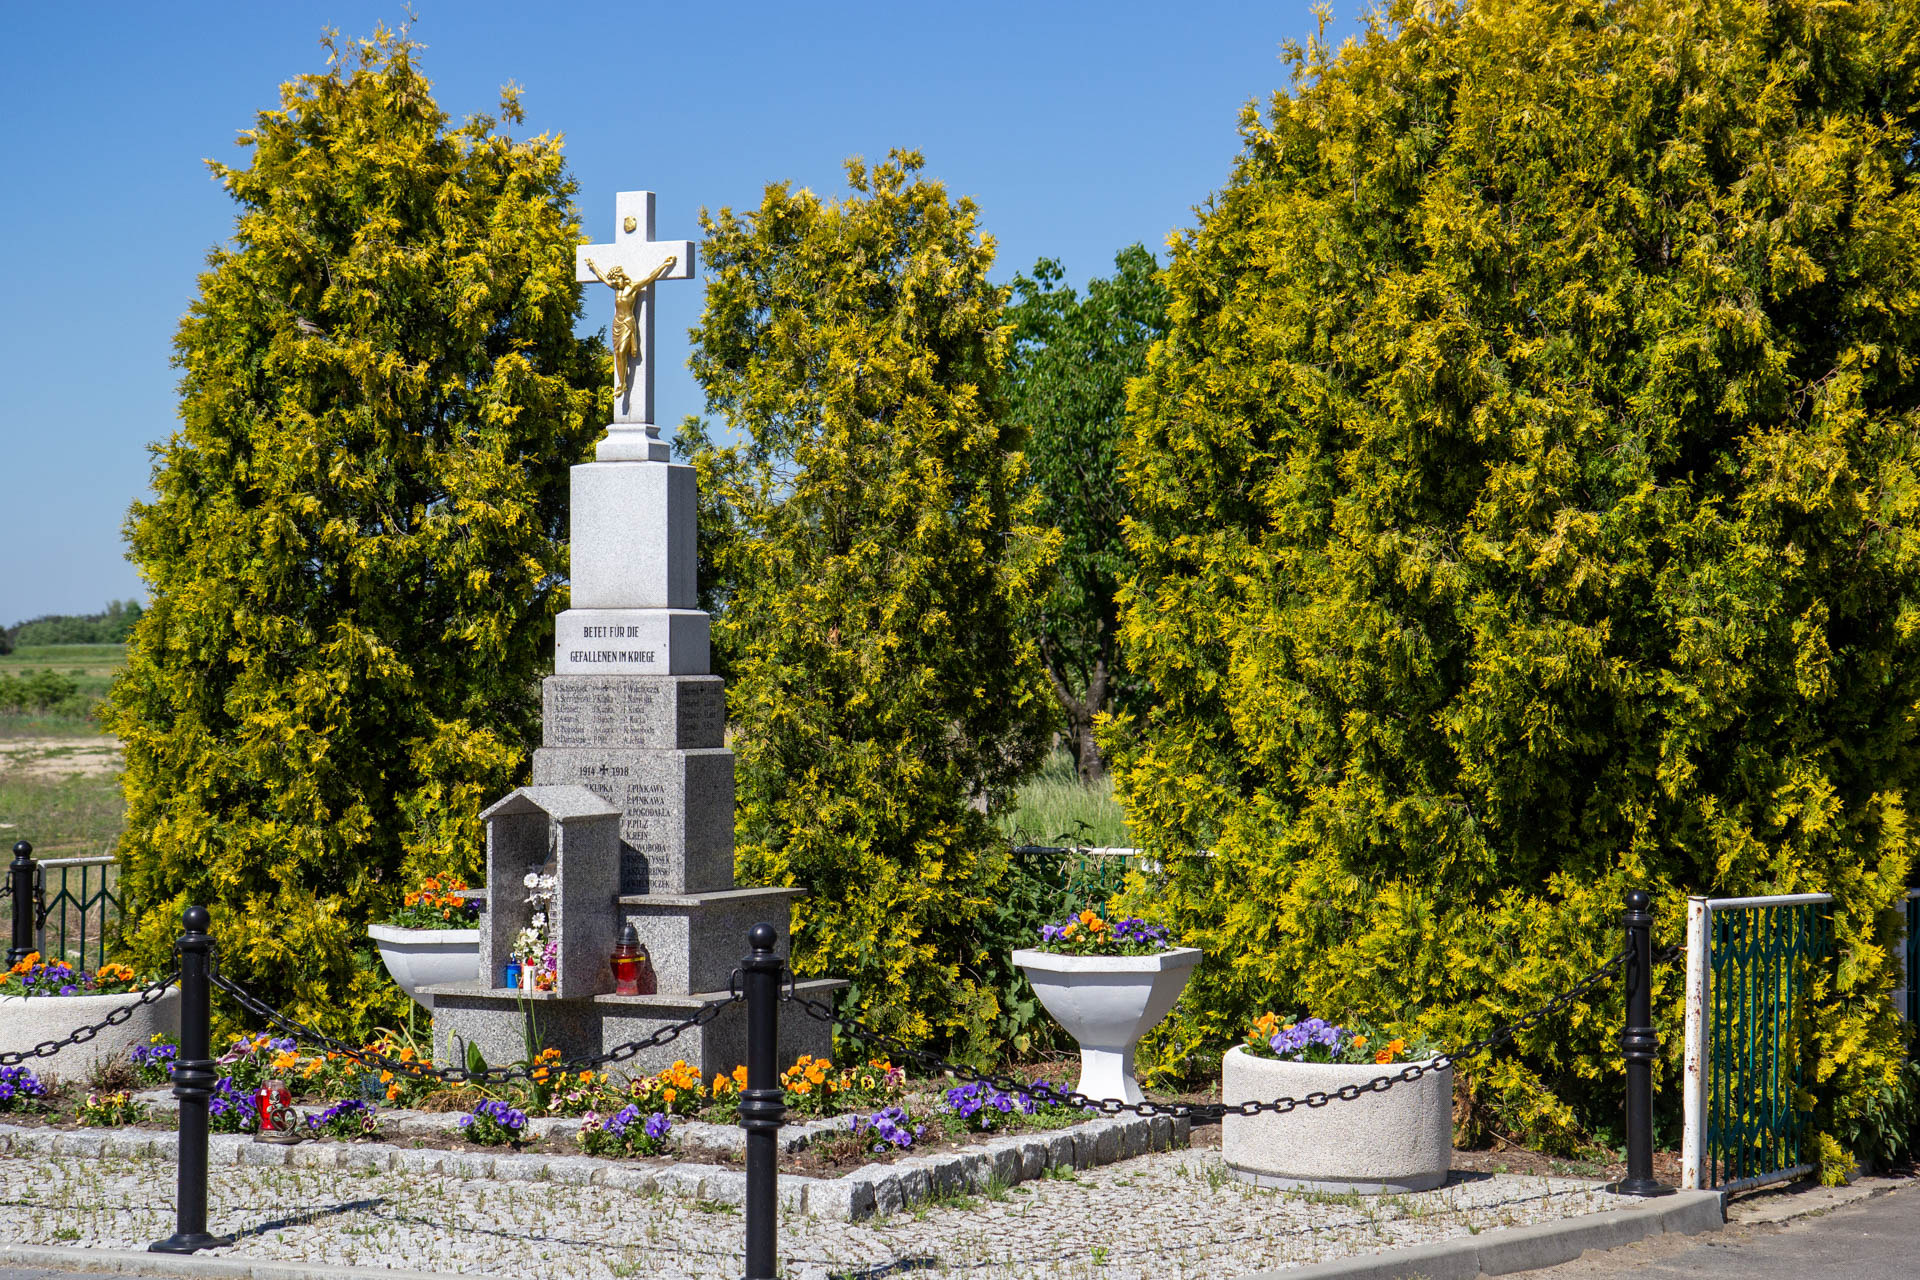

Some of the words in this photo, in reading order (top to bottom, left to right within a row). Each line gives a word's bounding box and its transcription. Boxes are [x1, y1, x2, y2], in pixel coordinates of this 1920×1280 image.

[583, 626, 607, 638] BETET
[627, 626, 640, 638] DIE
[570, 651, 618, 663] GEFALLENEN
[618, 651, 627, 663] IM
[628, 651, 655, 663] KRIEGE
[579, 766, 596, 776] 1914
[611, 766, 629, 776] 1918
